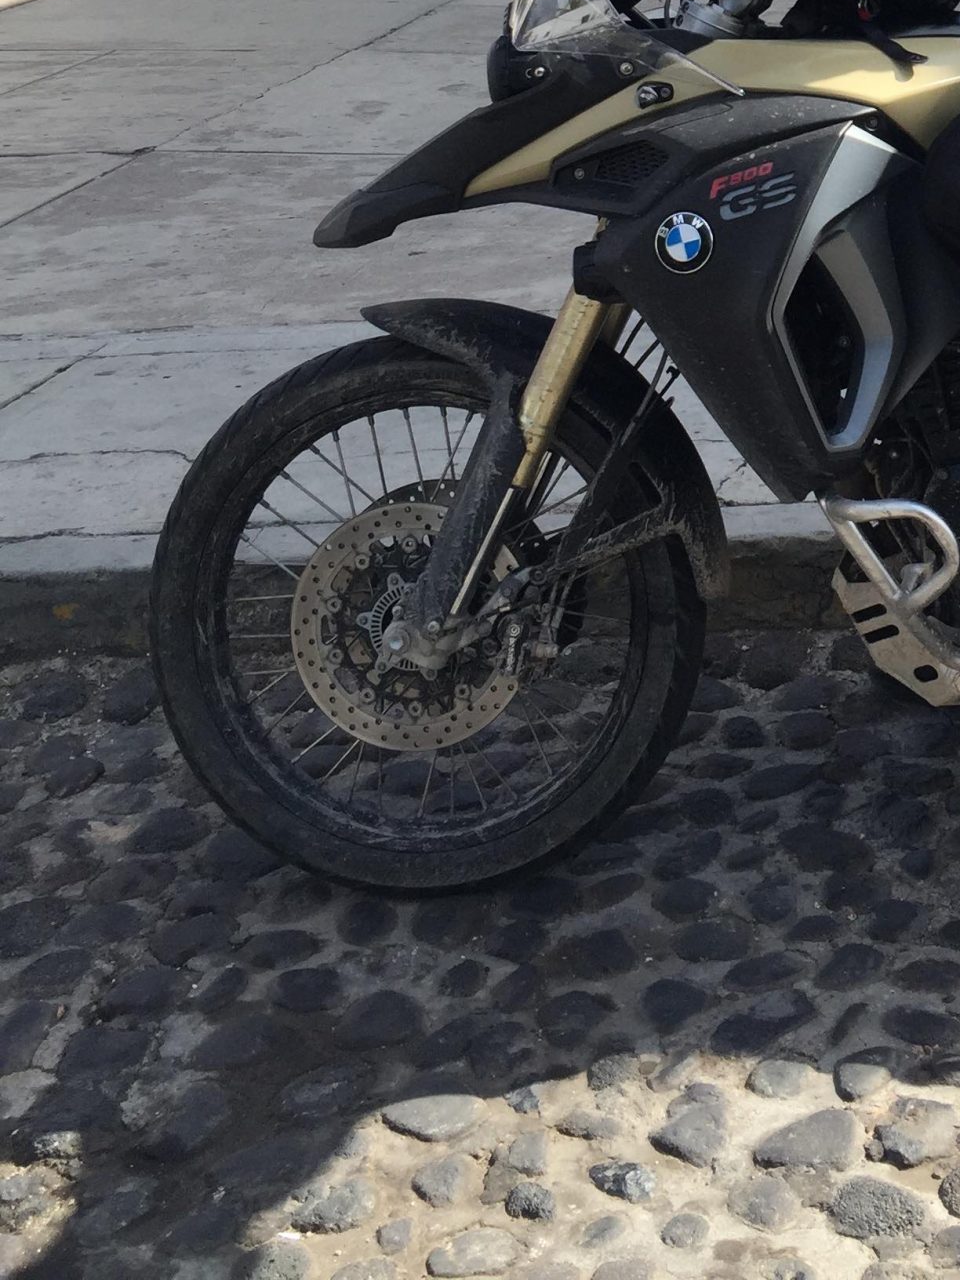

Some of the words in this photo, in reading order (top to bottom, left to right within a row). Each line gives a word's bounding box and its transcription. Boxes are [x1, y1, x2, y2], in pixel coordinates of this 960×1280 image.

[709, 162, 774, 199] F800
[720, 173, 798, 220] GS
[658, 214, 705, 238] BMW
